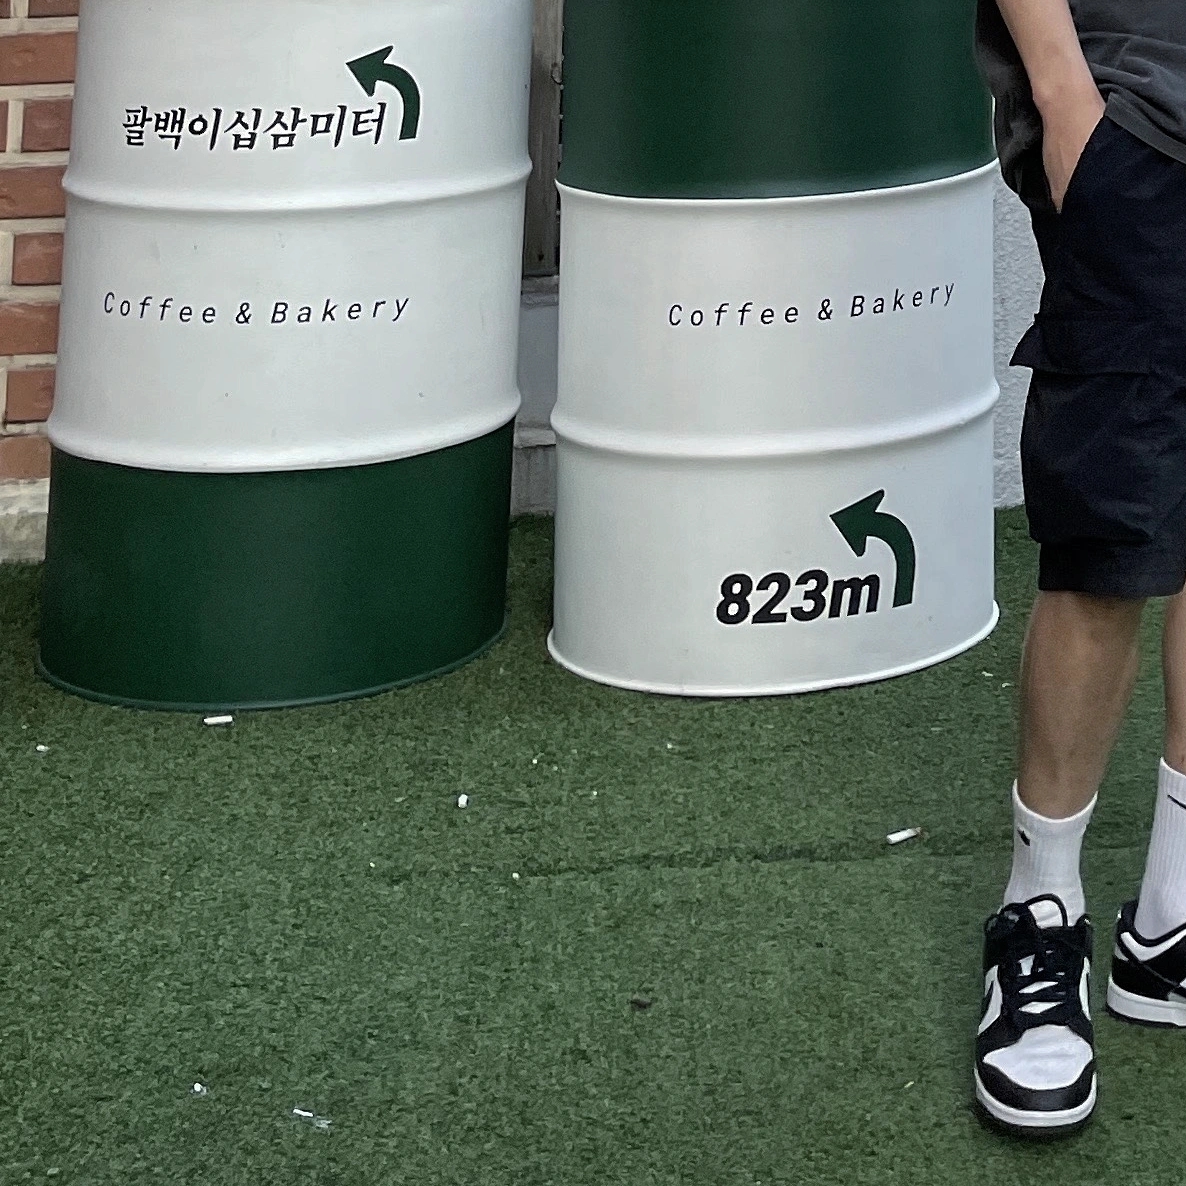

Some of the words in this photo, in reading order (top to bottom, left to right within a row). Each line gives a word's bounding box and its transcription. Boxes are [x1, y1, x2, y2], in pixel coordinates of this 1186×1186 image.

[122, 102, 387, 151] 팔백이십삼미터
[103, 292, 217, 324] Coffee
[235, 302, 252, 325] &
[271, 297, 410, 324] Bakery
[669, 302, 800, 327] Coffee
[817, 299, 833, 321] &
[850, 283, 955, 318] Bakery
[715, 569, 881, 625] 823m
